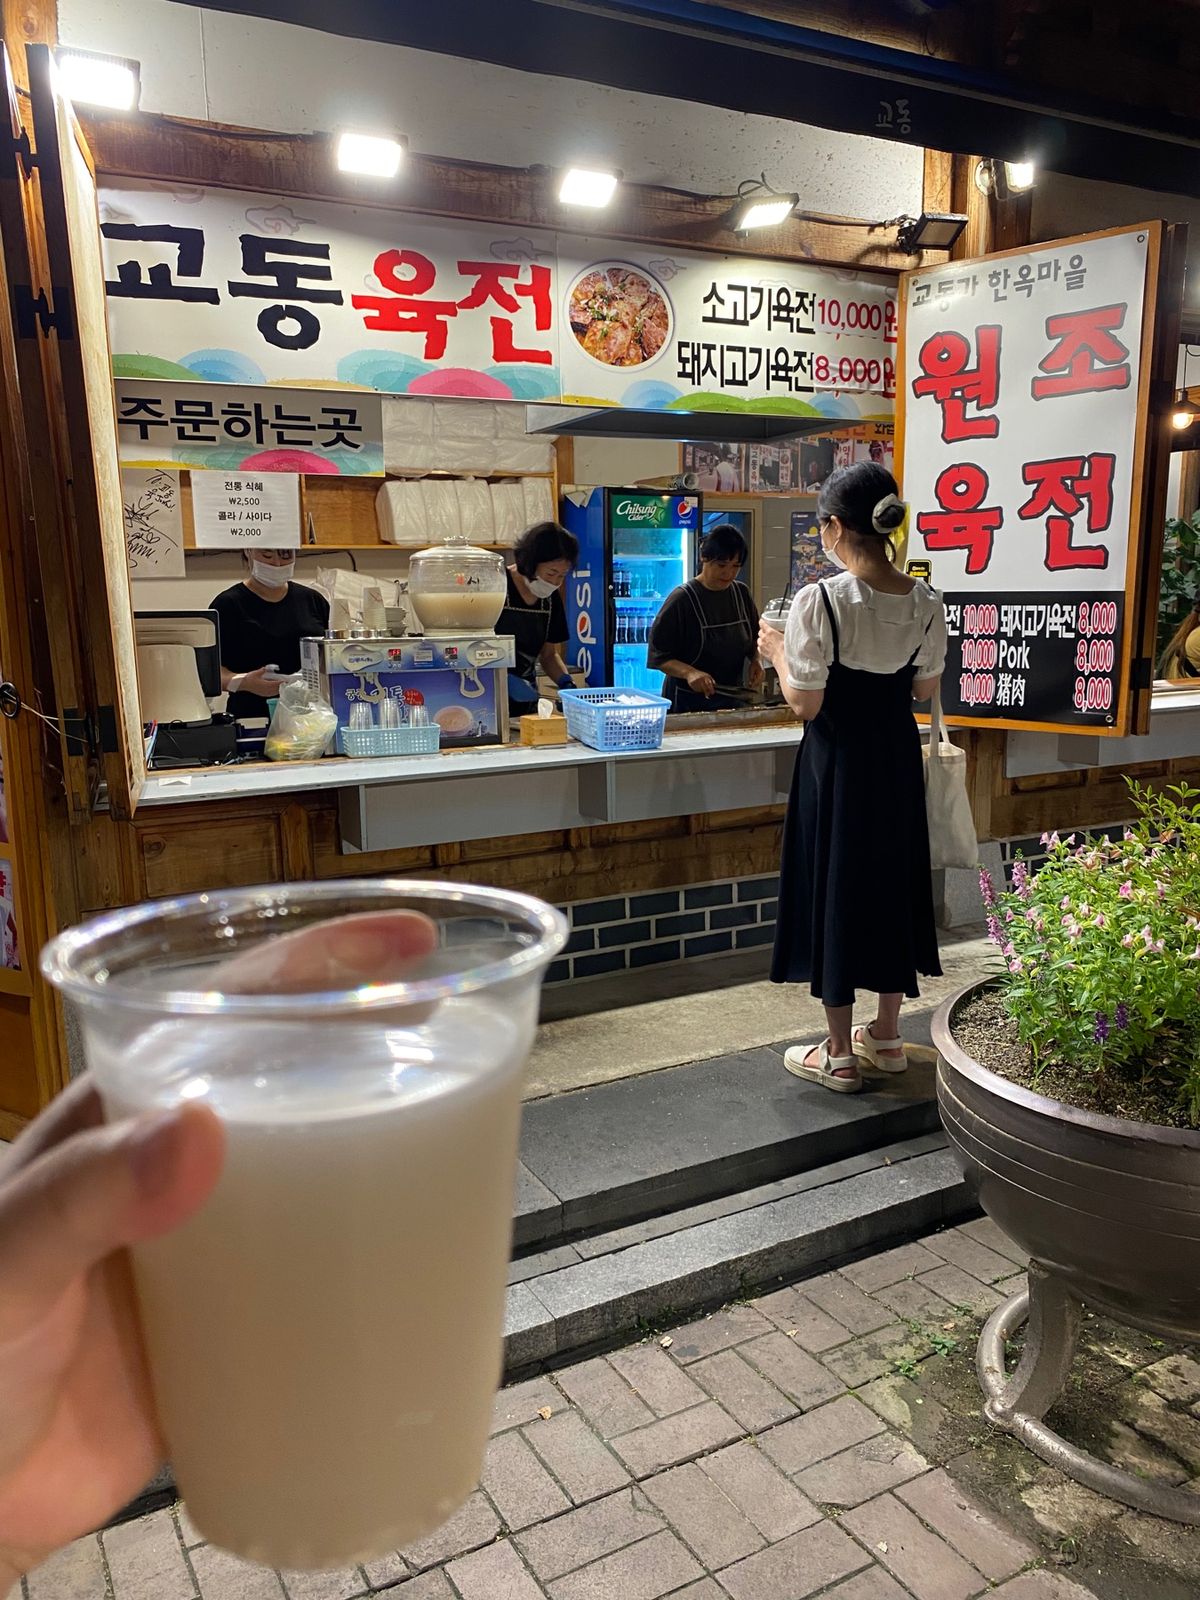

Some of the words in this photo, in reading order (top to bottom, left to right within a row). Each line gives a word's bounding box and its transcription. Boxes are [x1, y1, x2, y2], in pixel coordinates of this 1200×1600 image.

[875, 99, 911, 134] 교동
[988, 254, 1087, 302] 한옥마을
[118, 397, 363, 449] 주문하는곳
[224, 481, 243, 491] 전통
[245, 481, 263, 492] 식혜
[218, 511, 236, 521] 콜라
[245, 511, 272, 522] 사이다
[616, 500, 657, 519] Chilsung
[628, 513, 646, 522] Cider
[963, 604, 998, 638] 10,000
[1000, 603, 1076, 638] 돼지고기육전
[1078, 602, 1117, 638] 8,000
[962, 639, 997, 672] 10,000
[999, 640, 1030, 669] Pork
[1076, 639, 1114, 675] 8,000
[960, 673, 995, 707] 10,000
[996, 673, 1026, 706] 猪肉
[1073, 676, 1112, 712] 8,000
